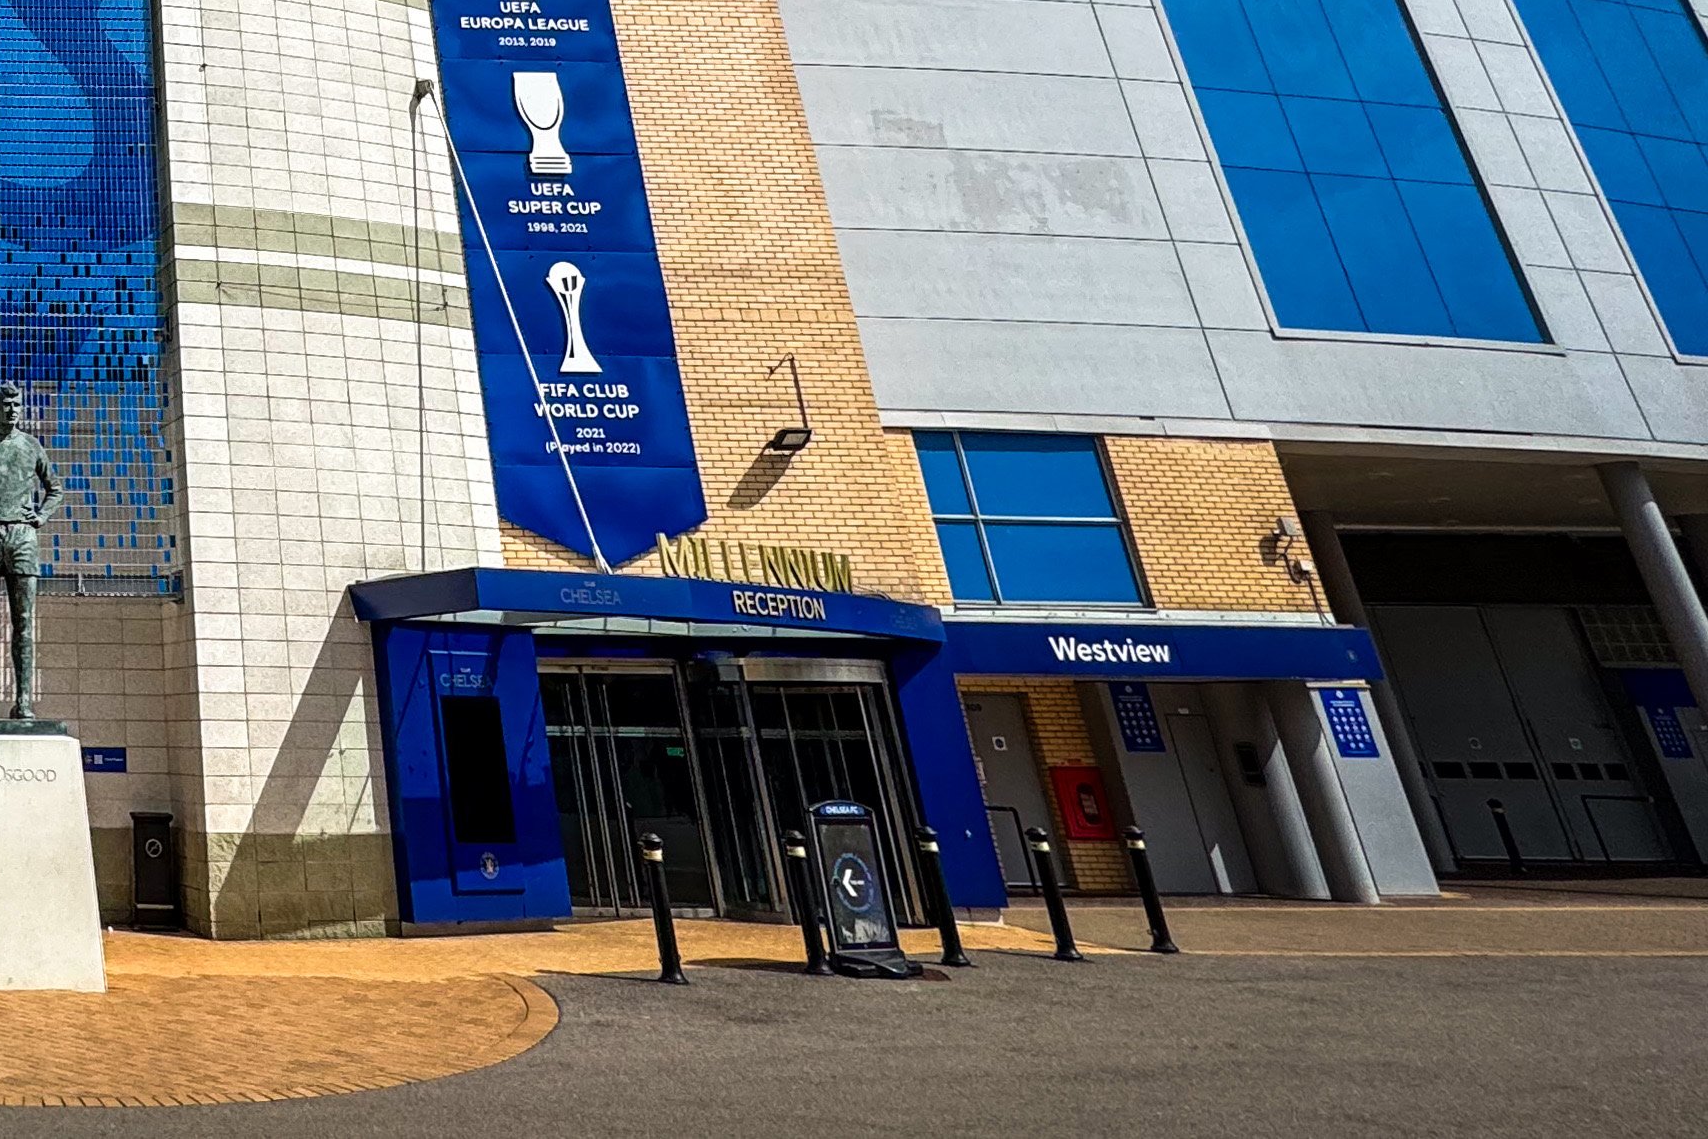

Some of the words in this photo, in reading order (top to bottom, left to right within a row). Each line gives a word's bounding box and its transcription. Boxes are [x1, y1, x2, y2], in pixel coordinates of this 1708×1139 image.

[500, 2, 541, 14] UEFA
[460, 17, 525, 30] EUROPA
[528, 18, 589, 32] LEAGUE
[498, 37, 529, 47] 2013,
[530, 38, 557, 47] 2019
[531, 183, 574, 196] UEFA
[508, 200, 562, 214] SUPER
[566, 202, 601, 215] CUP
[527, 222, 559, 234] 1998,
[561, 223, 588, 233] 2021
[540, 384, 579, 398] FIFA
[583, 384, 629, 398] CLUB
[534, 403, 599, 418] WORLD
[603, 404, 640, 419] CUP
[576, 428, 606, 439] 2021
[546, 442, 590, 455] (Payed
[593, 443, 604, 453] in
[606, 443, 641, 455] 2022)
[656, 533, 853, 595] MILLENNIUM
[561, 588, 622, 606] CHELSEA
[733, 590, 827, 621] RECEPTION
[1048, 637, 1170, 663] Westview
